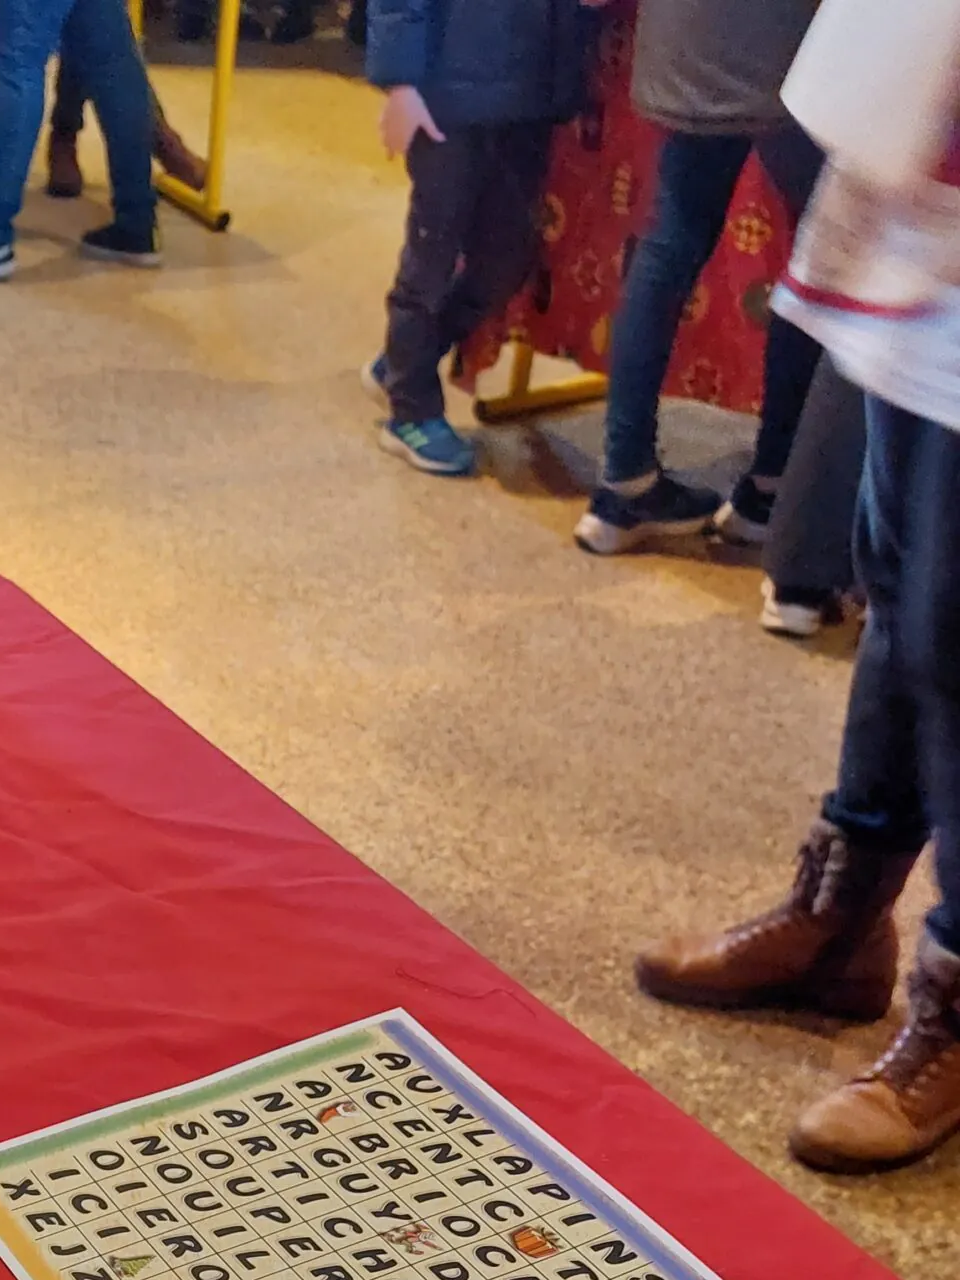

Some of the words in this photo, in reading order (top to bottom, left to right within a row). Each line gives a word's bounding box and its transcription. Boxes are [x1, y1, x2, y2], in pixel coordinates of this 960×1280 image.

[0, 1179, 40, 1201] X
[25, 1212, 66, 1233] E
[71, 1194, 108, 1214] C
[89, 1150, 125, 1171] O
[136, 1208, 178, 1228] E
[162, 1235, 203, 1258] R
[130, 1136, 170, 1156] N
[156, 1163, 193, 1184] O
[184, 1191, 223, 1212] U
[235, 1250, 270, 1270] L
[173, 1121, 209, 1140] S
[198, 1149, 235, 1170] O
[226, 1176, 265, 1197] U
[249, 1206, 291, 1224] P
[278, 1237, 323, 1258] E
[213, 1109, 250, 1128] A
[238, 1135, 277, 1156] R
[271, 1161, 309, 1179] T
[323, 1217, 363, 1238] C
[352, 1248, 398, 1273] H
[253, 1092, 294, 1112] N
[280, 1119, 319, 1140] R
[313, 1148, 351, 1168] G
[339, 1173, 379, 1193] U
[371, 1201, 413, 1221] Y
[295, 1080, 332, 1099] A
[350, 1133, 390, 1153] B
[377, 1158, 419, 1180] R
[441, 1215, 481, 1238] O
[475, 1245, 517, 1268] C
[335, 1063, 375, 1083] N
[365, 1090, 402, 1109] C
[393, 1119, 434, 1138] E
[420, 1142, 463, 1164] N
[454, 1168, 494, 1187] T
[484, 1200, 524, 1222] C
[556, 1260, 599, 1280] T
[375, 1052, 412, 1071] A
[431, 1104, 474, 1124] X
[463, 1129, 495, 1147] L
[493, 1155, 533, 1175] A
[527, 1183, 571, 1201] P
[590, 1240, 638, 1265] N
